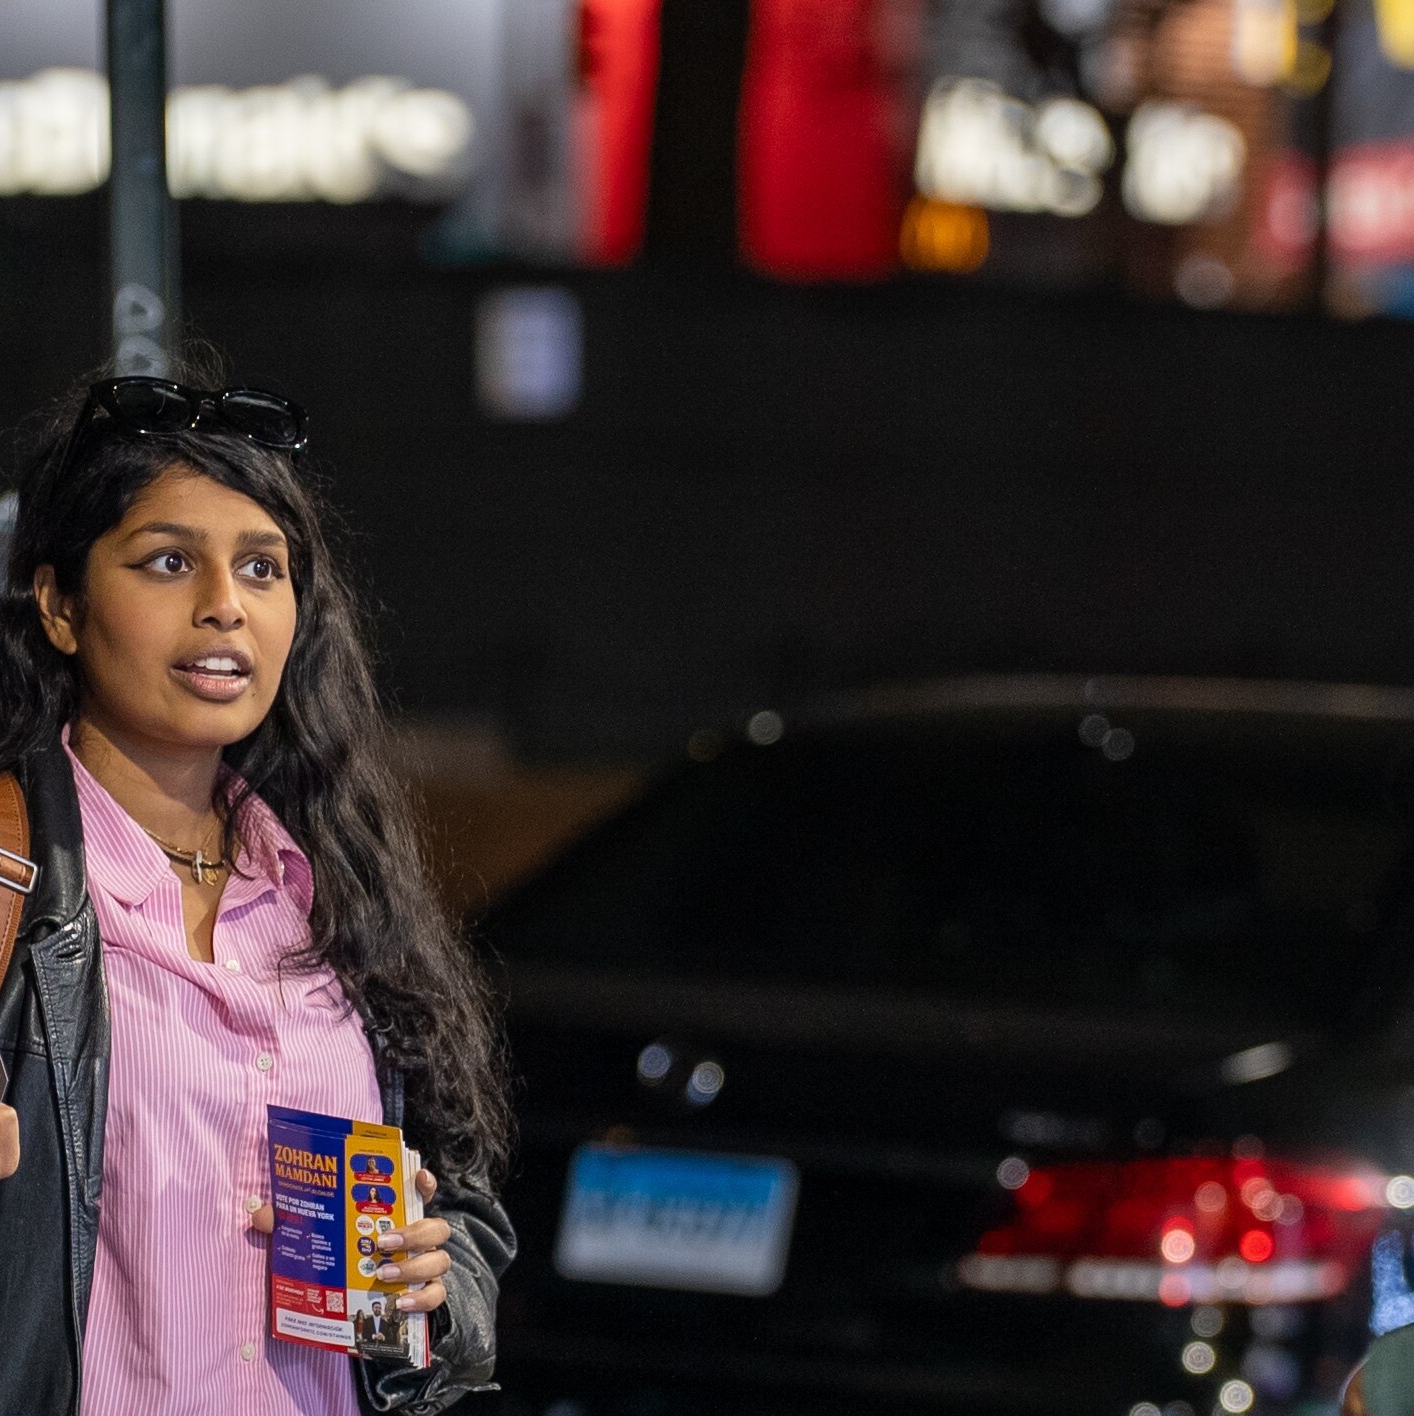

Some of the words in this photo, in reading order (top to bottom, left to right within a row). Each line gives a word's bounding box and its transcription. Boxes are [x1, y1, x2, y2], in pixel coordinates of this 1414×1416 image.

[274, 1144, 338, 1173] ZOHRAN
[275, 1163, 337, 1189] MAMDANI
[275, 1201, 289, 1211] PARA
[298, 1206, 317, 1218] NUEVA
[317, 1211, 335, 1221] YORK
[289, 1196, 300, 1206] POR
[300, 1199, 325, 1211] ZOHRAN
